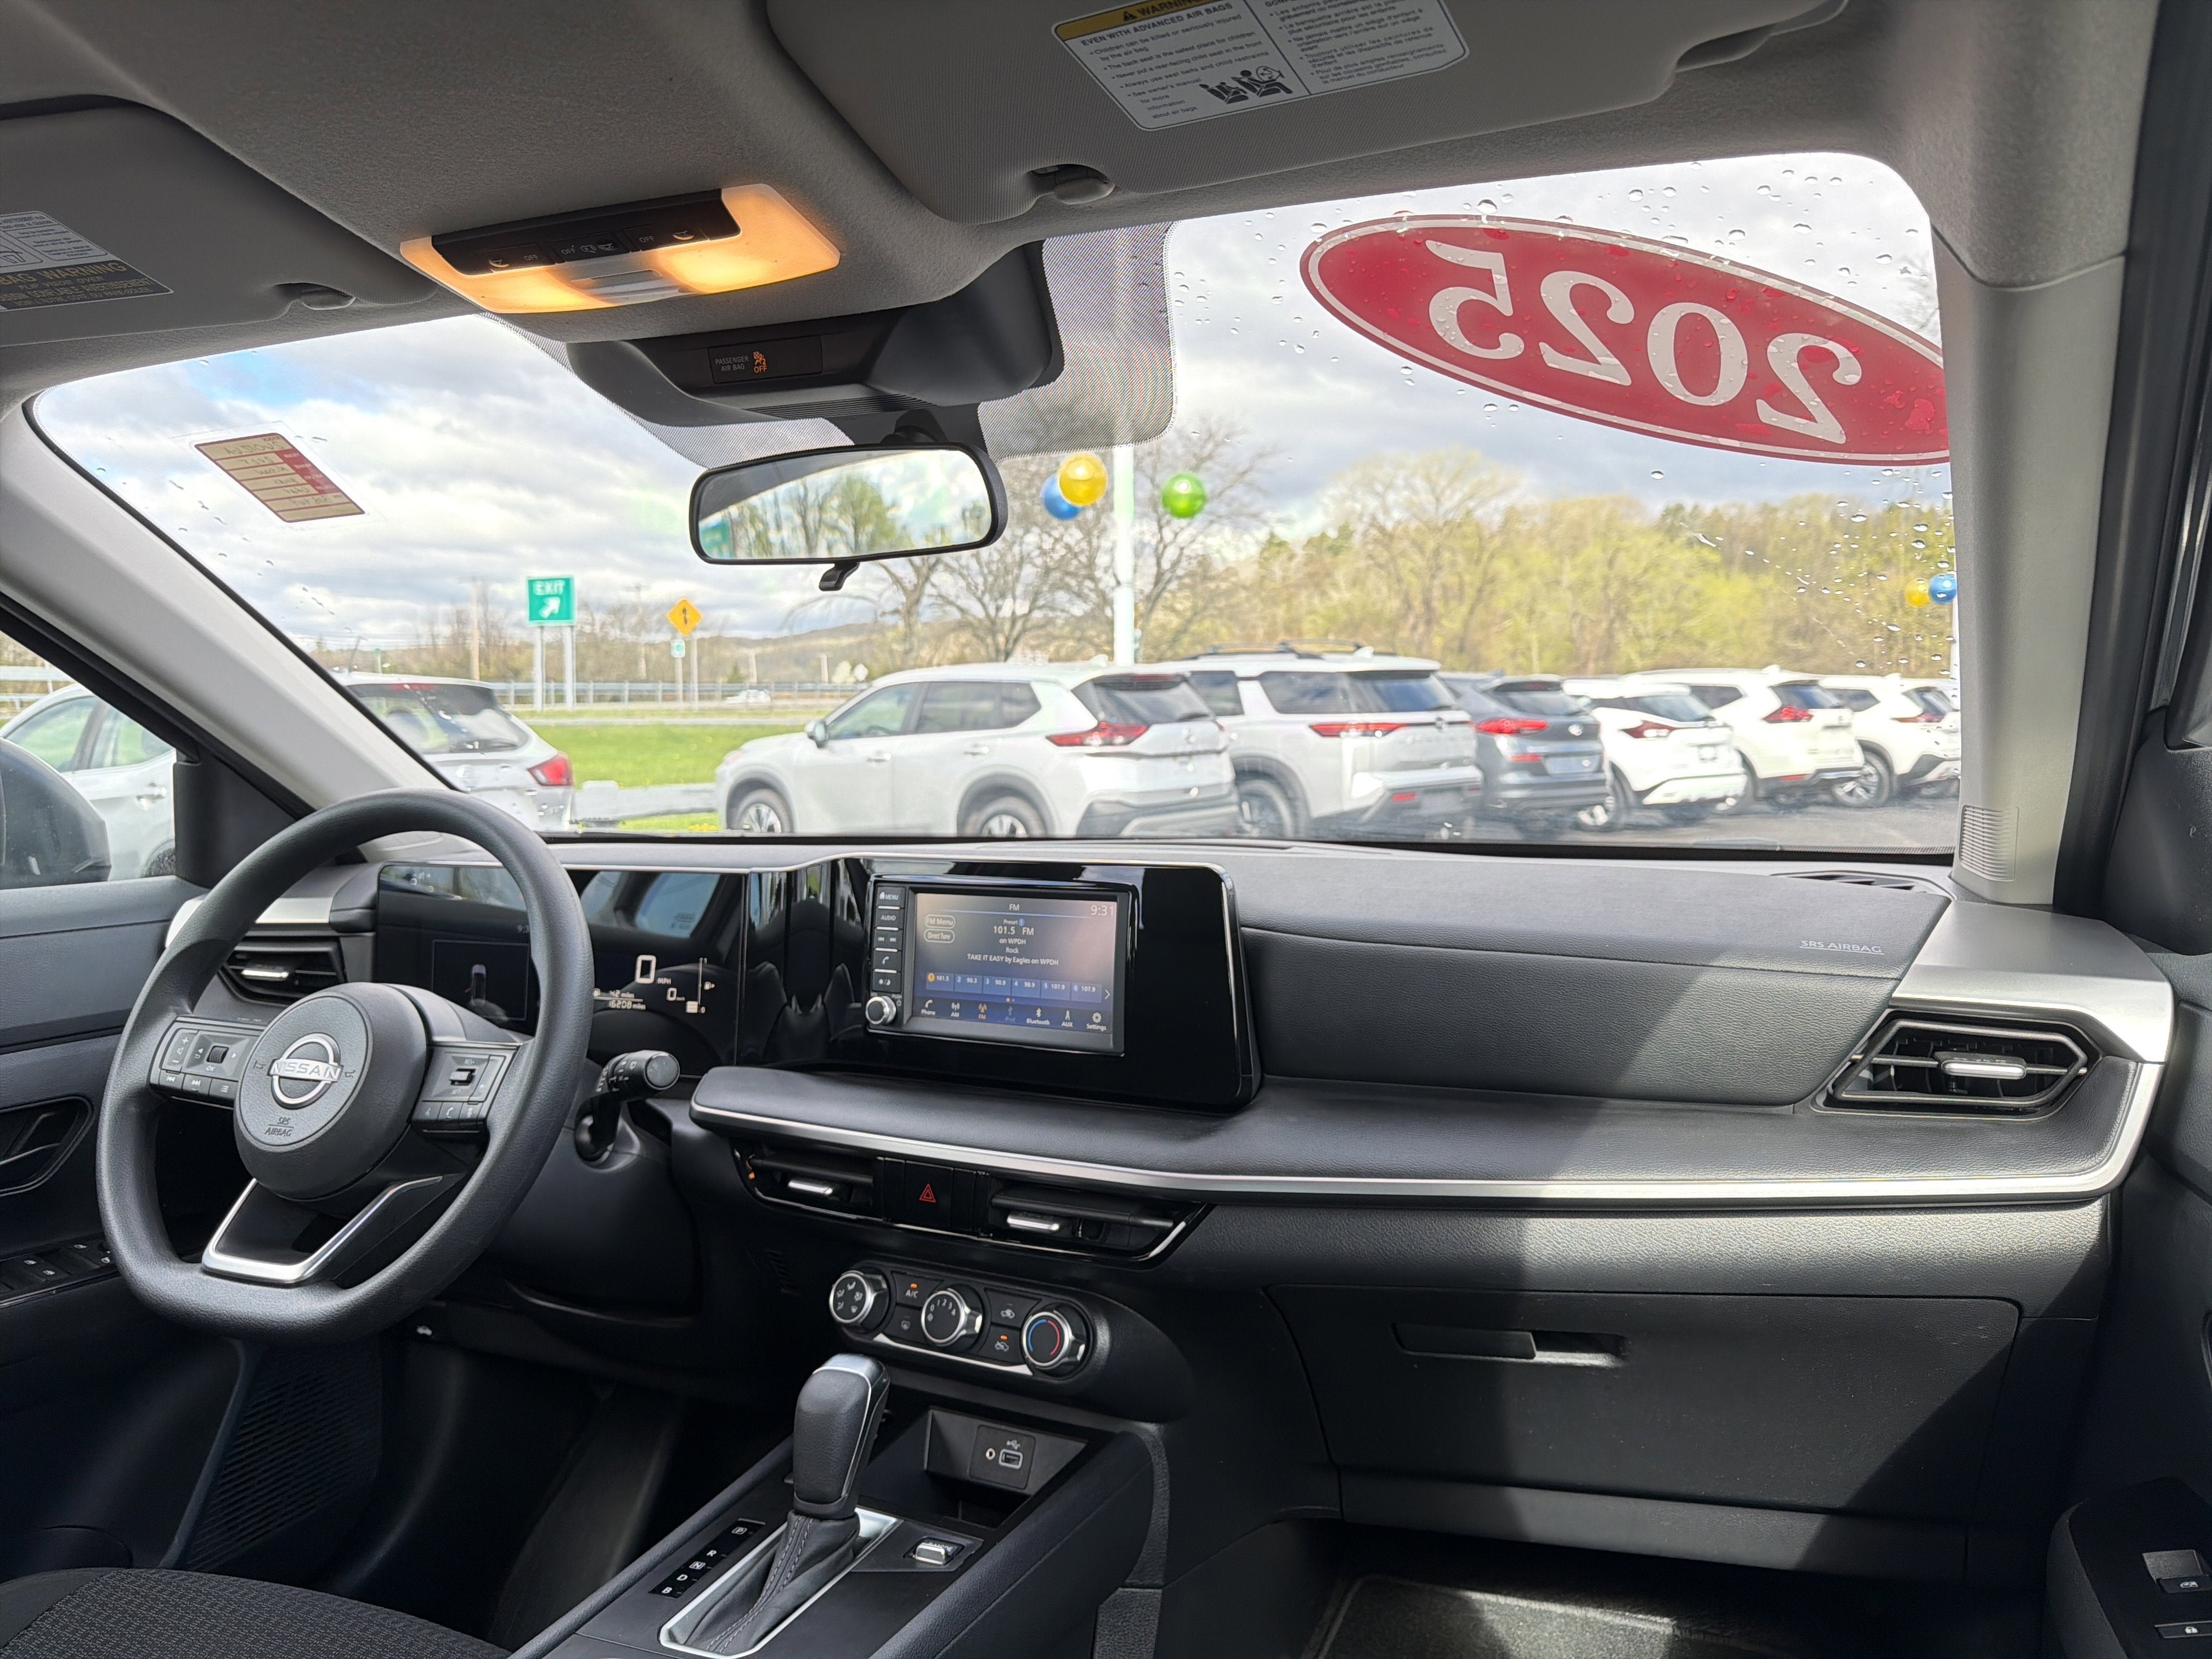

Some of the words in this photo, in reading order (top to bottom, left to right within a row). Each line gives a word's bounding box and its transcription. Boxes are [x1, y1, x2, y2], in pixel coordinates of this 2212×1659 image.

[36, 263, 127, 279] WARNING
[715, 356, 749, 365] PASSENGER
[533, 580, 565, 595] EXIT
[1091, 905, 1114, 917] 9:31
[994, 926, 1015, 935] 101.5
[1022, 927, 1034, 935] FM
[1828, 943, 1882, 953] AIRBAG
[1005, 956, 1012, 964] by
[635, 955, 657, 984] 0
[1086, 1023, 1107, 1032] Settings
[273, 1061, 341, 1080] NISSAN
[264, 1127, 292, 1137] AIRBAG
[905, 1289, 918, 1298] A/C
[941, 1298, 947, 1306] 2
